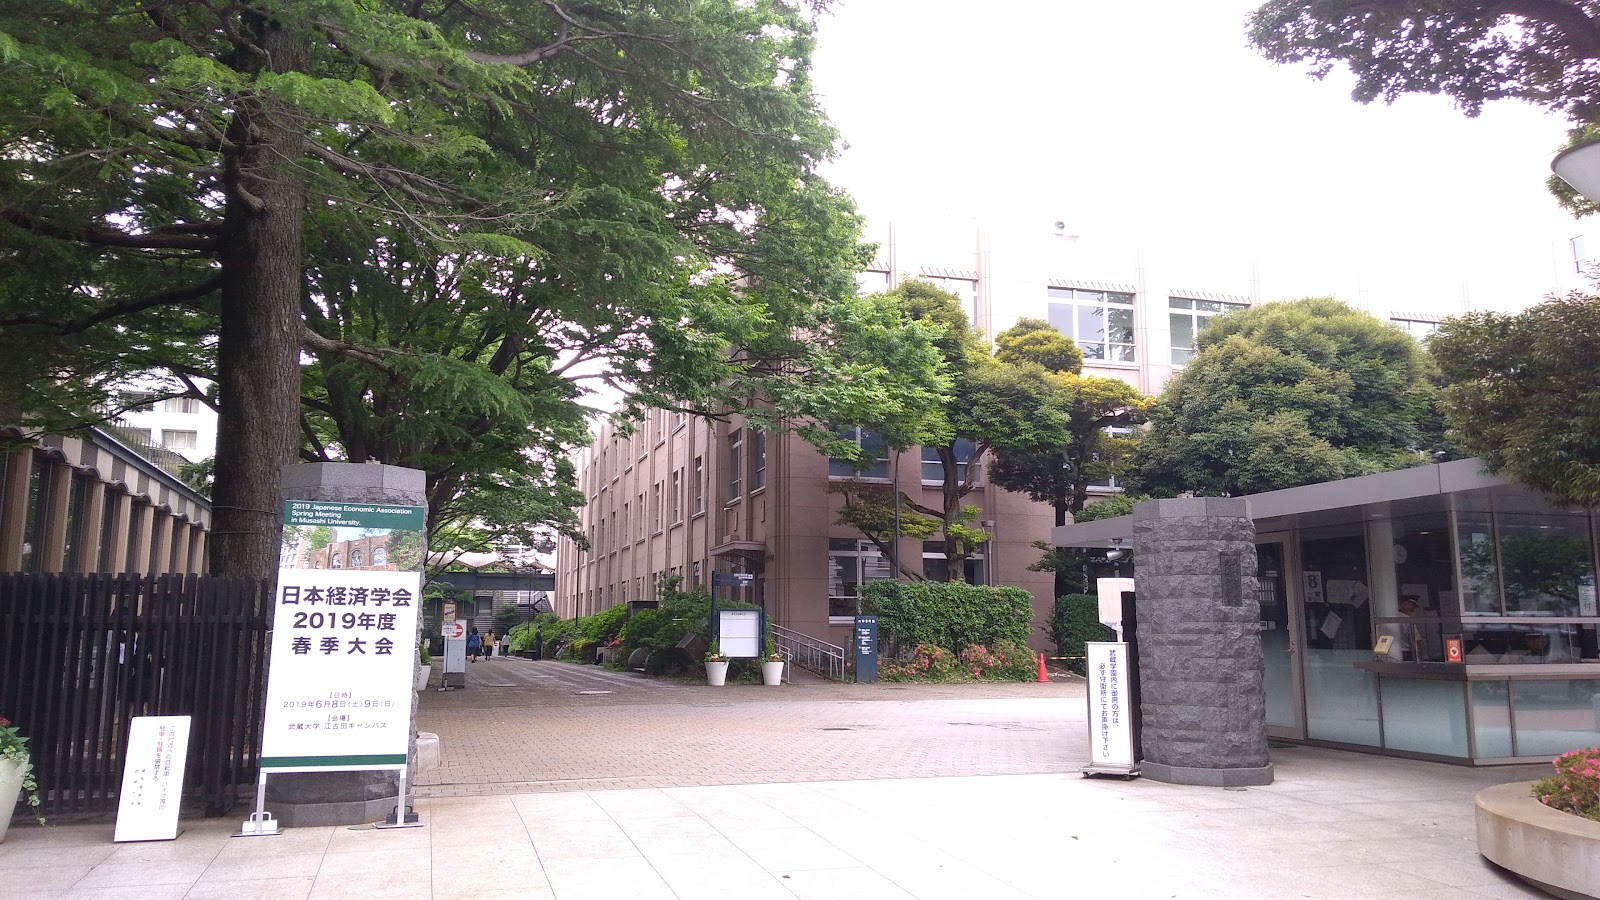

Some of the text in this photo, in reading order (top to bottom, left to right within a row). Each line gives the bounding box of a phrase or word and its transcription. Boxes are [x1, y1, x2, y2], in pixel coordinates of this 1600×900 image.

[291, 510, 342, 519] Spring Meeting
[311, 504, 342, 512] Japanese
[375, 507, 413, 515] Association
[327, 518, 361, 526] University.
[1307, 574, 1318, 588] 8
[281, 586, 412, 607] 日本経済学会
[292, 612, 397, 630] 2019年度
[324, 722, 387, 730] 江古田キャンパス
